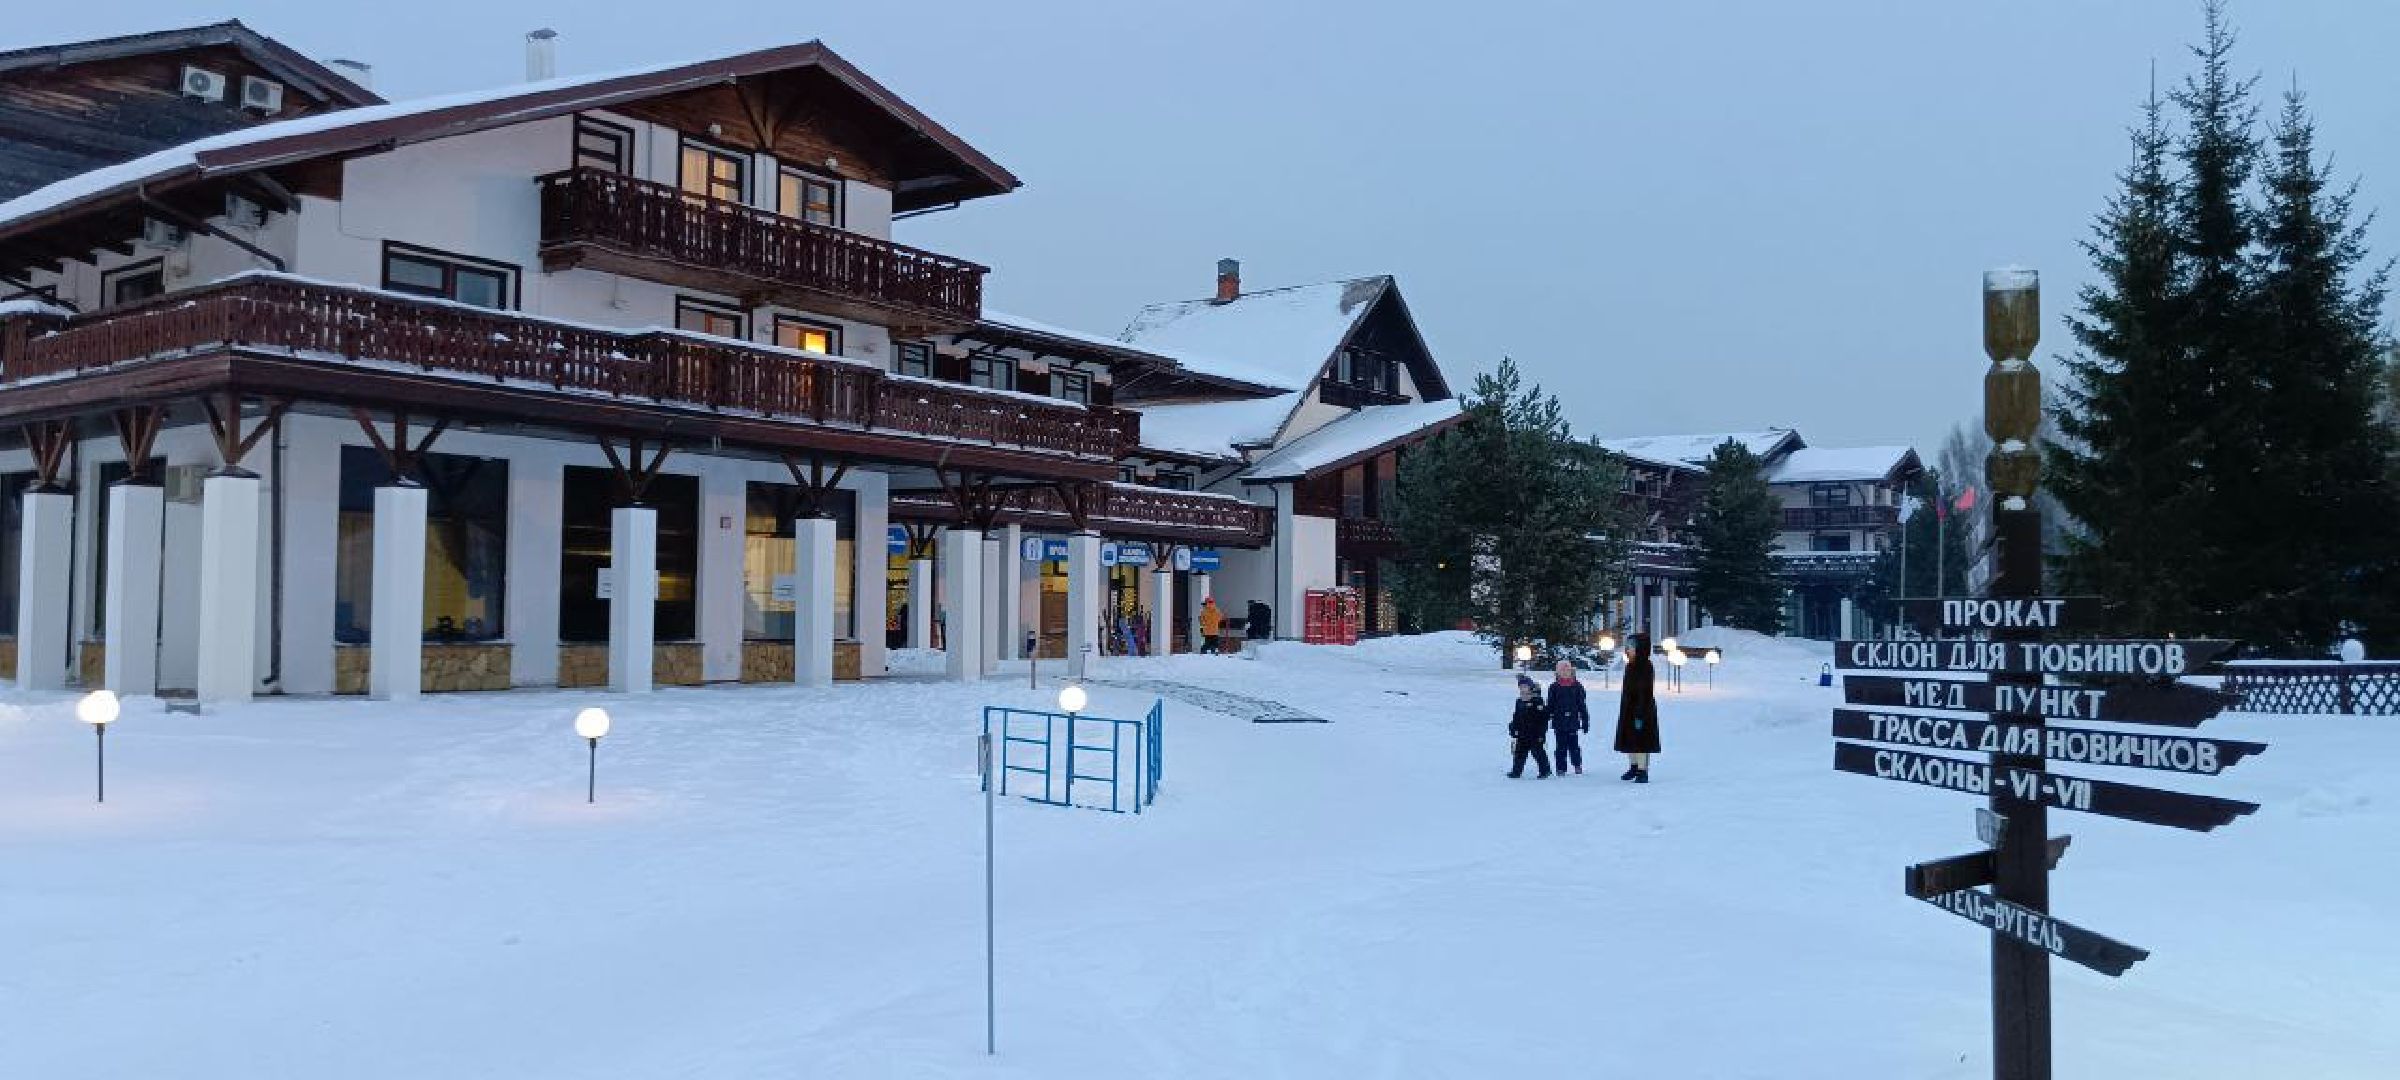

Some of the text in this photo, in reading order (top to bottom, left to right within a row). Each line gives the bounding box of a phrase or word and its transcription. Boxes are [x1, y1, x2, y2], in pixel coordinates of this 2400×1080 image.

[1943, 600, 2065, 627] ПРОКАТ
[1851, 642, 2185, 674] СКЛОН ДЛЯ ТЮБИНГОВ
[1904, 681, 2107, 719] МЕД ПУНКТ
[1868, 714, 2218, 773] ТРАССА ДЛЯ НОВИЧКОВ
